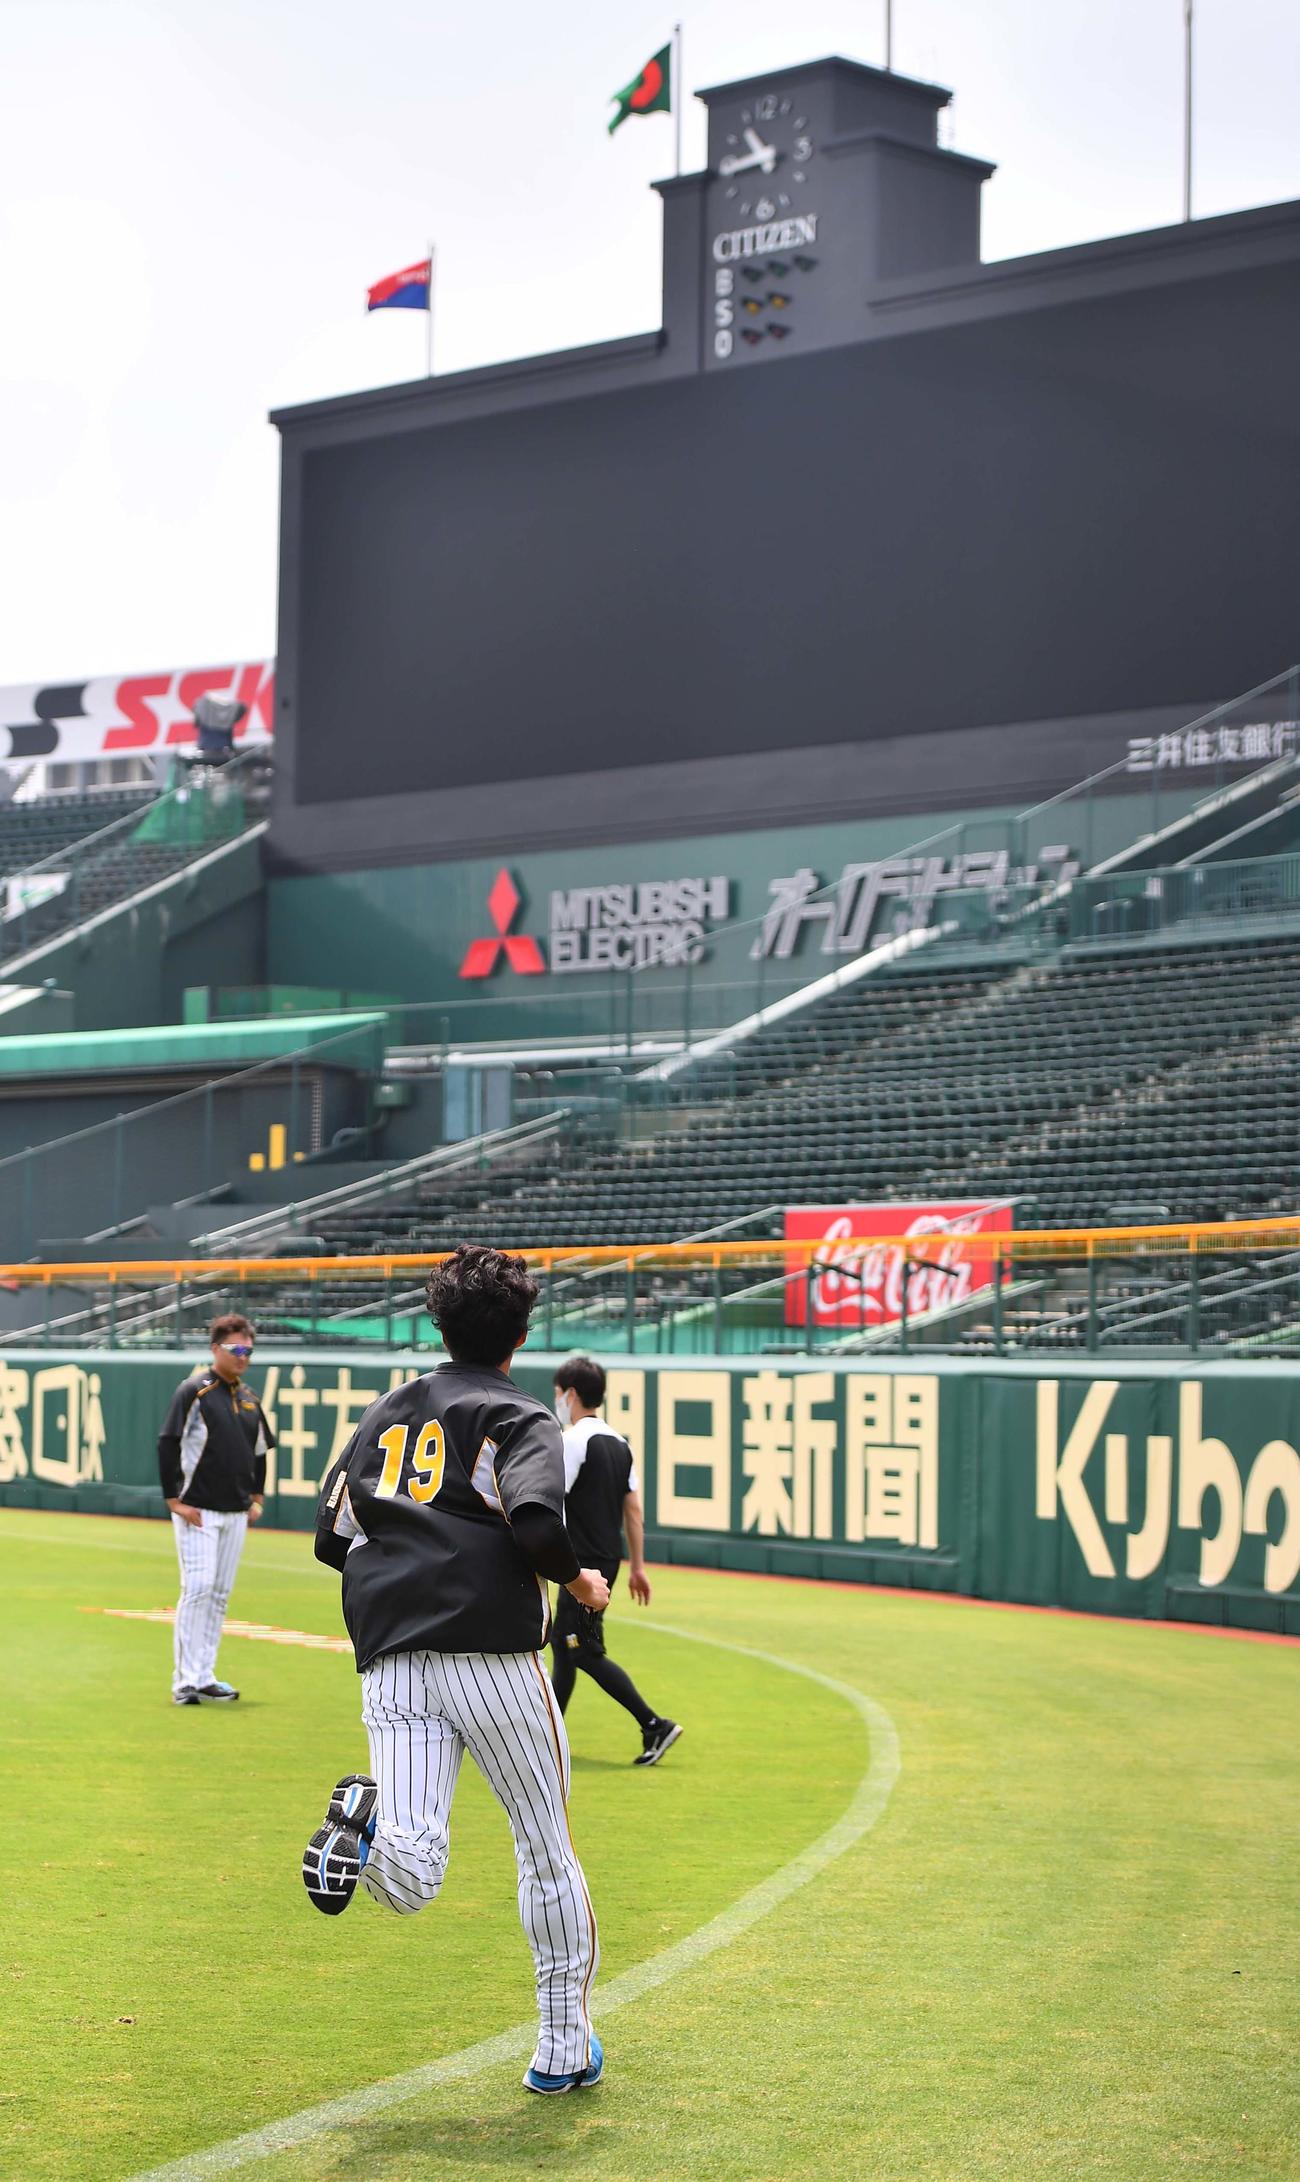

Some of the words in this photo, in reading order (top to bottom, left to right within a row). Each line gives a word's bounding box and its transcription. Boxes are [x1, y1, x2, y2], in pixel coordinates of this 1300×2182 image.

[755, 95, 777, 120] 12
[794, 136, 812, 162] 3
[756, 197, 776, 221] 6
[713, 214, 817, 262] CITIZEN
[716, 268, 733, 296] B
[716, 299, 733, 328] S
[550, 876, 728, 929] MITSUBISHI
[550, 921, 704, 973] ELECTRIC
[374, 1418, 446, 1504] 19
